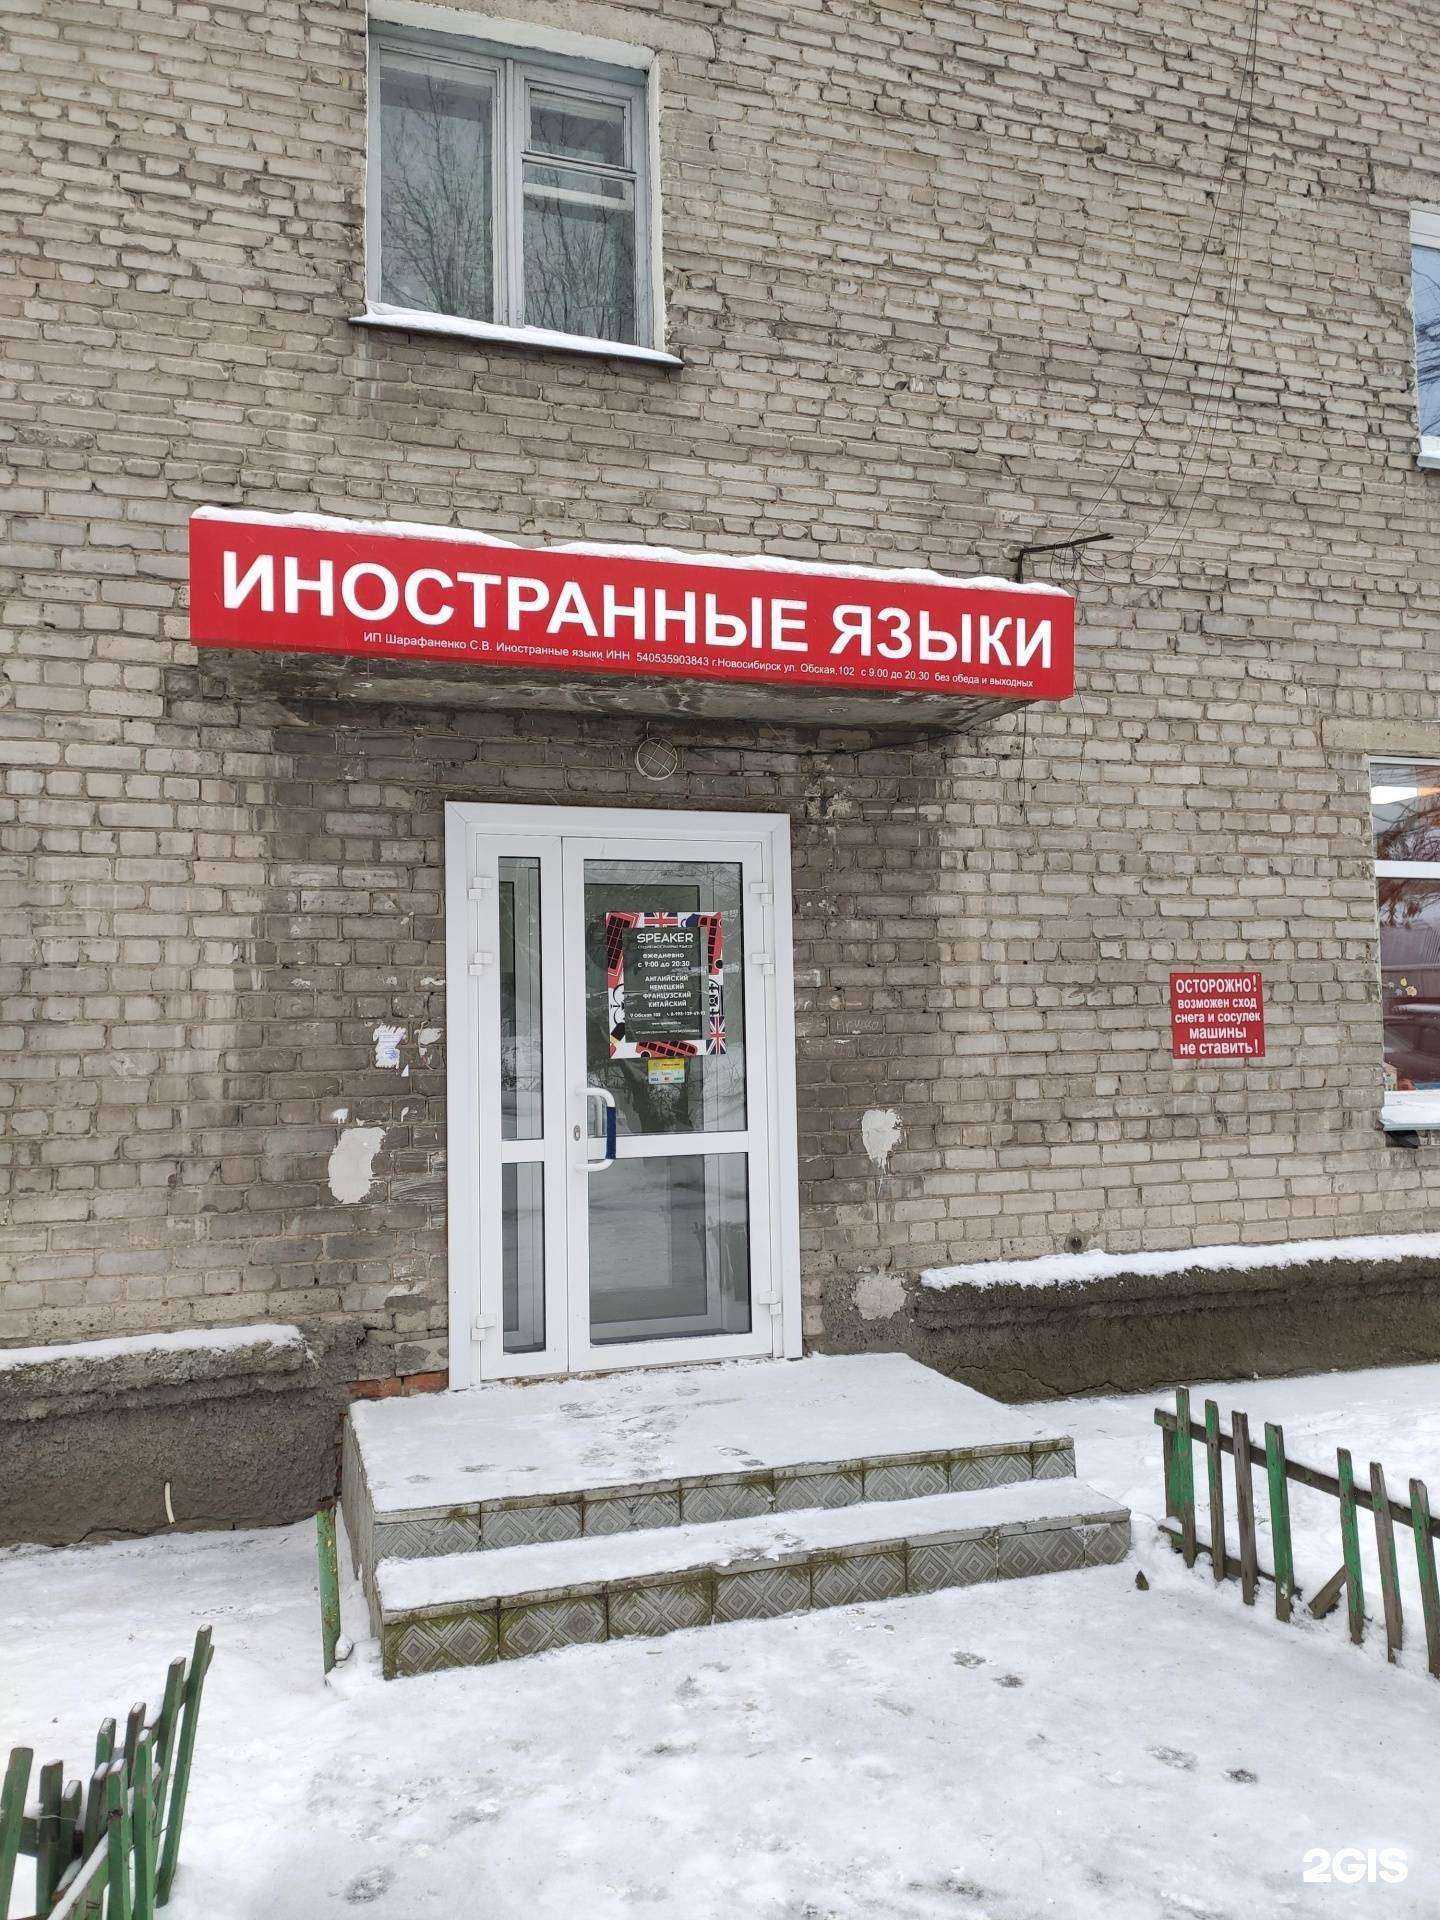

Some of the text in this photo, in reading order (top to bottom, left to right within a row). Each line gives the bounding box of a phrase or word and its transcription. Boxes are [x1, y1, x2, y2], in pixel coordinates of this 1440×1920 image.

[222, 549, 1053, 669] ИНОСТРАННЫЕ ЯЗЫКИ
[363, 631, 382, 643] ИП
[385, 634, 467, 649] Шарафаненко
[469, 640, 493, 652] С.В.
[496, 642, 569, 657] Иностранные
[571, 648, 604, 660] языки
[606, 650, 630, 661] ИНН
[636, 652, 709, 666] 540535903843
[783, 664, 797, 674] ул.
[860, 669, 867, 677] с
[868, 668, 889, 678] 9.00
[890, 671, 903, 680] до
[905, 670, 930, 681] 20.30
[934, 673, 950, 683] без
[952, 674, 980, 685] обеда
[981, 677, 988, 685] и
[990, 678, 1034, 688] выходных
[636, 932, 694, 943] SPEAKER
[645, 974, 689, 982] АНГЛИЙСКИЙ
[1175, 974, 1257, 994] ОСТОРОЖНО!
[649, 983, 685, 991] НЕМЕЦКИЙ
[642, 991, 692, 999] ФРАНЦУЗСКИЙ
[648, 1000, 687, 1008] КИТАЙСКИЙ
[1177, 997, 1258, 1009] возможен сход
[1174, 1011, 1261, 1025] снега и сосулек
[1189, 1026, 1247, 1039] машины
[1179, 1038, 1259, 1055] не ставить!
